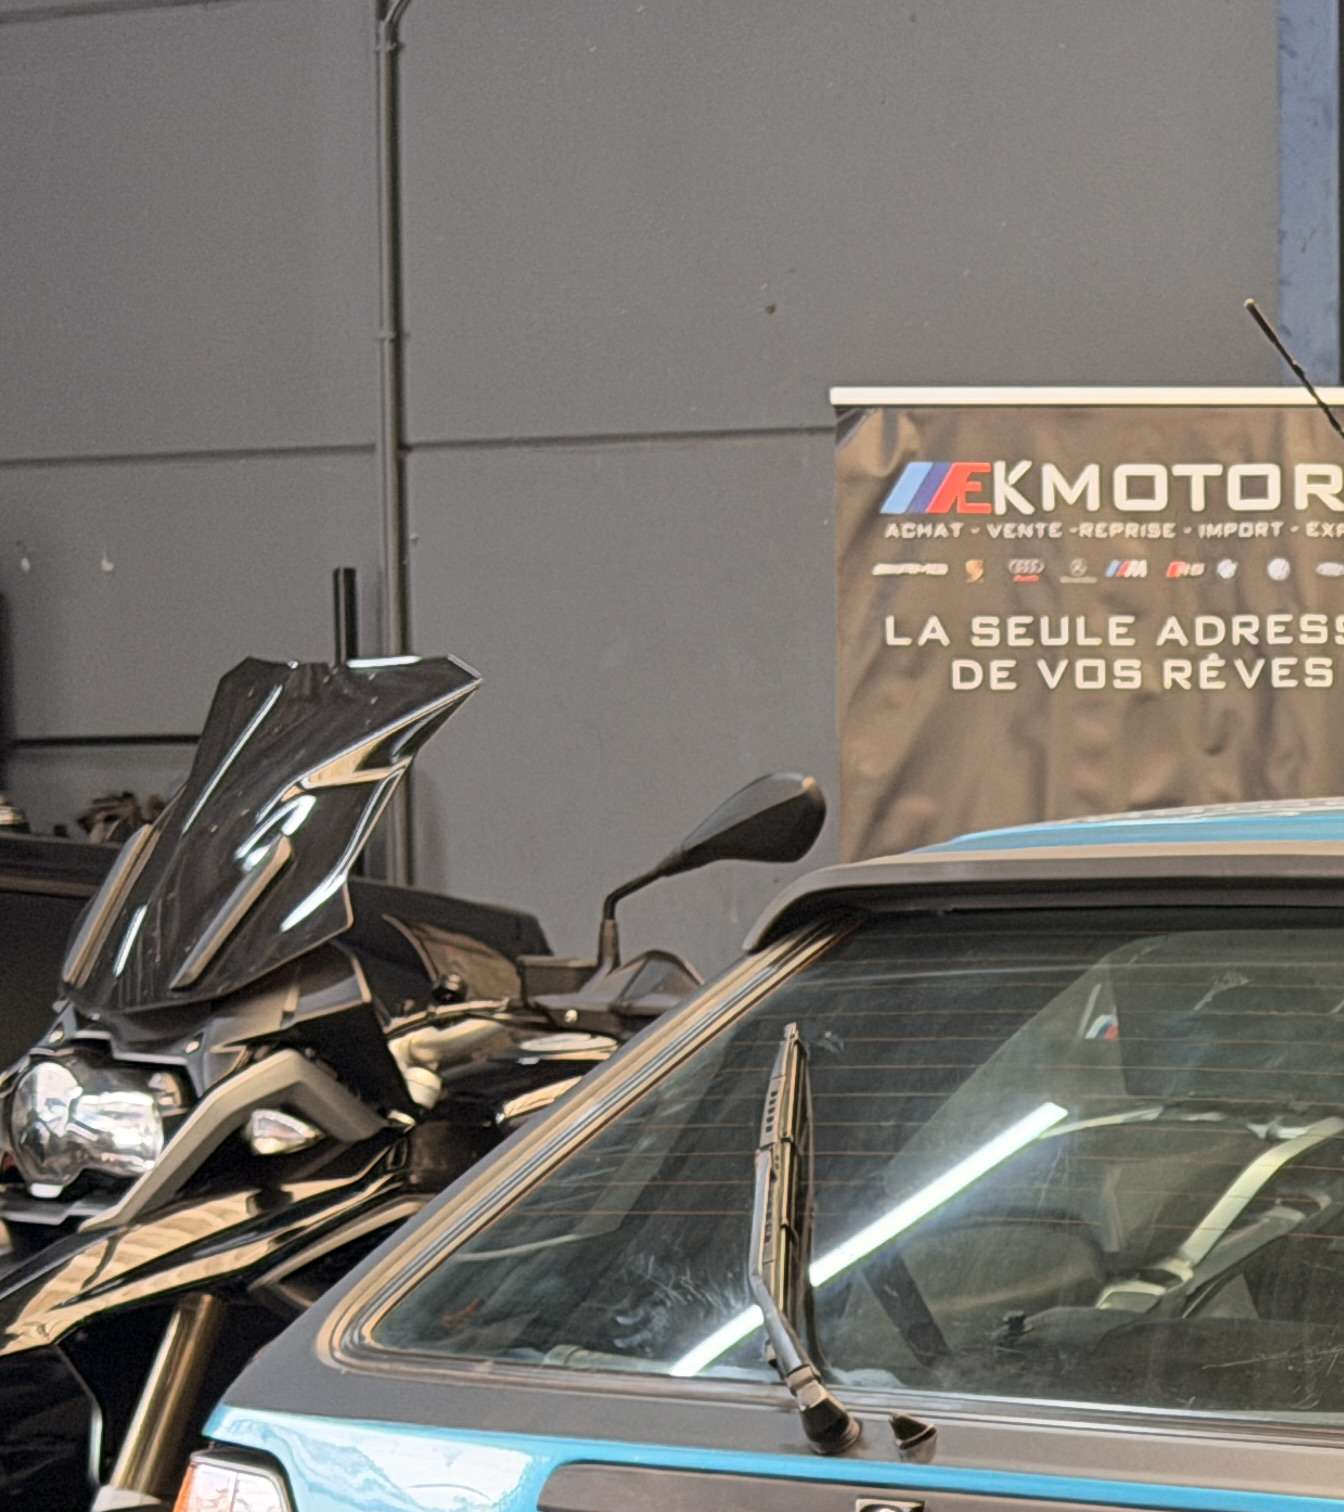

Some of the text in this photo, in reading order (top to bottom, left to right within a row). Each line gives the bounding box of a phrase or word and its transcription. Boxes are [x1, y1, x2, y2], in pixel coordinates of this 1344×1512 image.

[884, 522, 964, 540] ACHAT
[986, 522, 1063, 540] VENTE
[1198, 520, 1285, 540] IMPORT
[885, 615, 951, 647] LA
[970, 615, 1136, 647] SEULE
[952, 652, 1334, 690] DE VOS RÊVES
